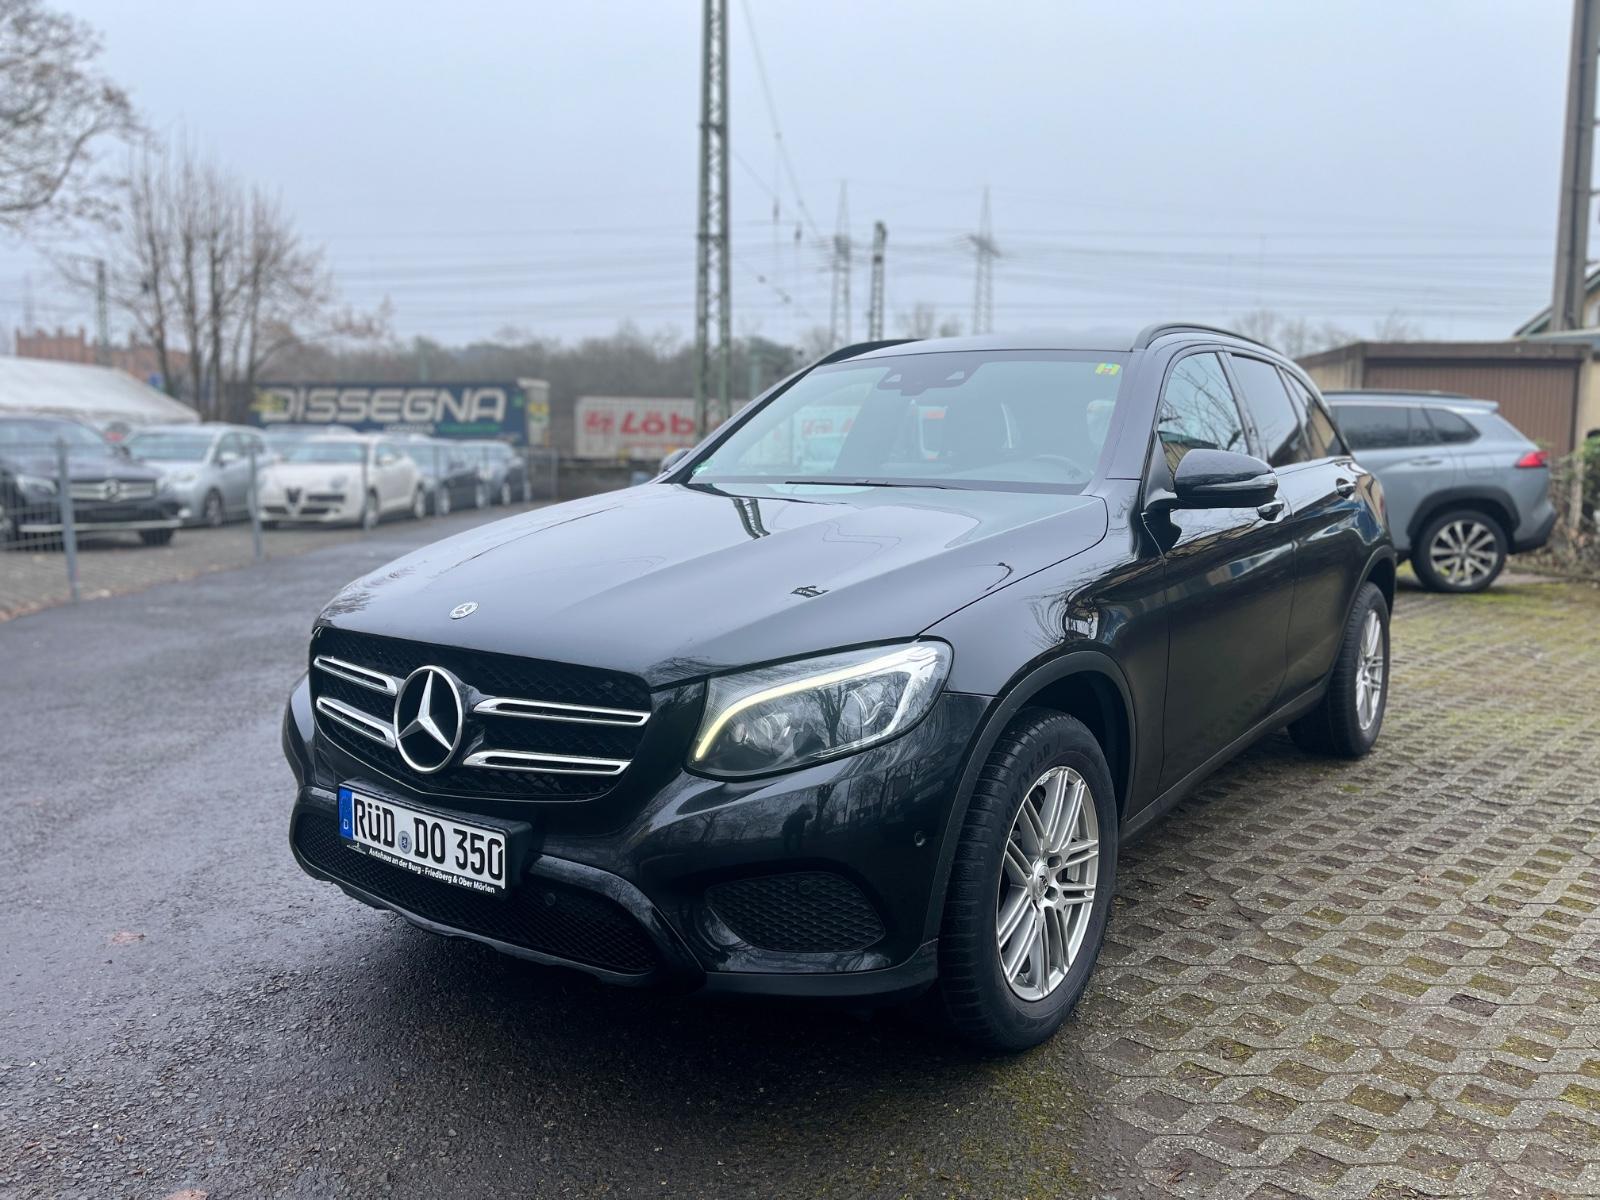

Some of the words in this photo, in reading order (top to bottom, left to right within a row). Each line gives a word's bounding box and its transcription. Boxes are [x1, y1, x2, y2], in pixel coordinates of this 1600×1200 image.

[259, 387, 507, 422] DISSEGNA
[343, 819, 349, 830] D
[413, 817, 446, 864] DO
[453, 828, 503, 880] 350
[369, 848, 392, 863] Autohaus
[399, 859, 408, 868] der
[408, 862, 421, 875] Burg
[425, 867, 452, 884] Friedberg
[459, 876, 472, 888] Ober
[474, 881, 495, 893] Mörlen
